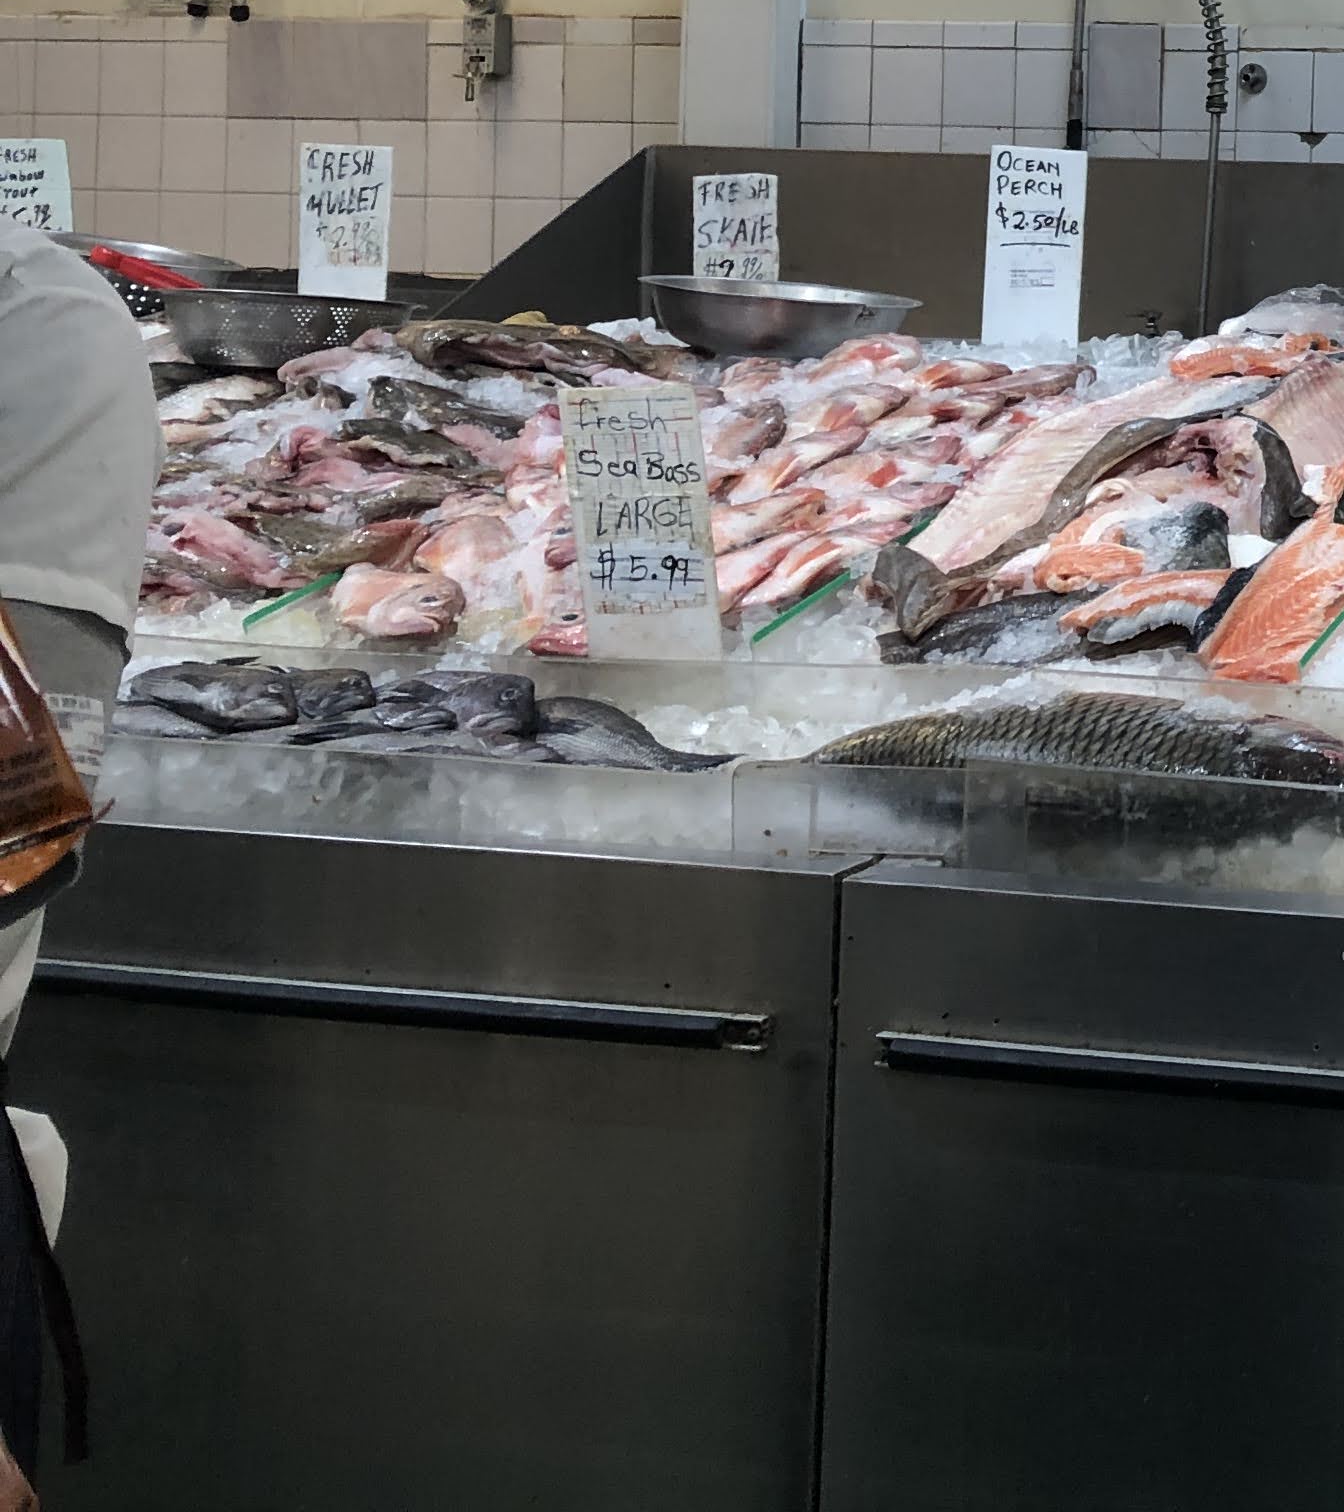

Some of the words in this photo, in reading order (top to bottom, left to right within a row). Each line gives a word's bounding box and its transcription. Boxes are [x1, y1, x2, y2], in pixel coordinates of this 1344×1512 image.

[0, 148, 37, 163] RESH
[996, 150, 1060, 177] OCEAN
[698, 177, 770, 206] FRESH
[996, 175, 1063, 199] PERCH
[697, 215, 773, 248] SKATE
[597, 496, 696, 537] LARGE
